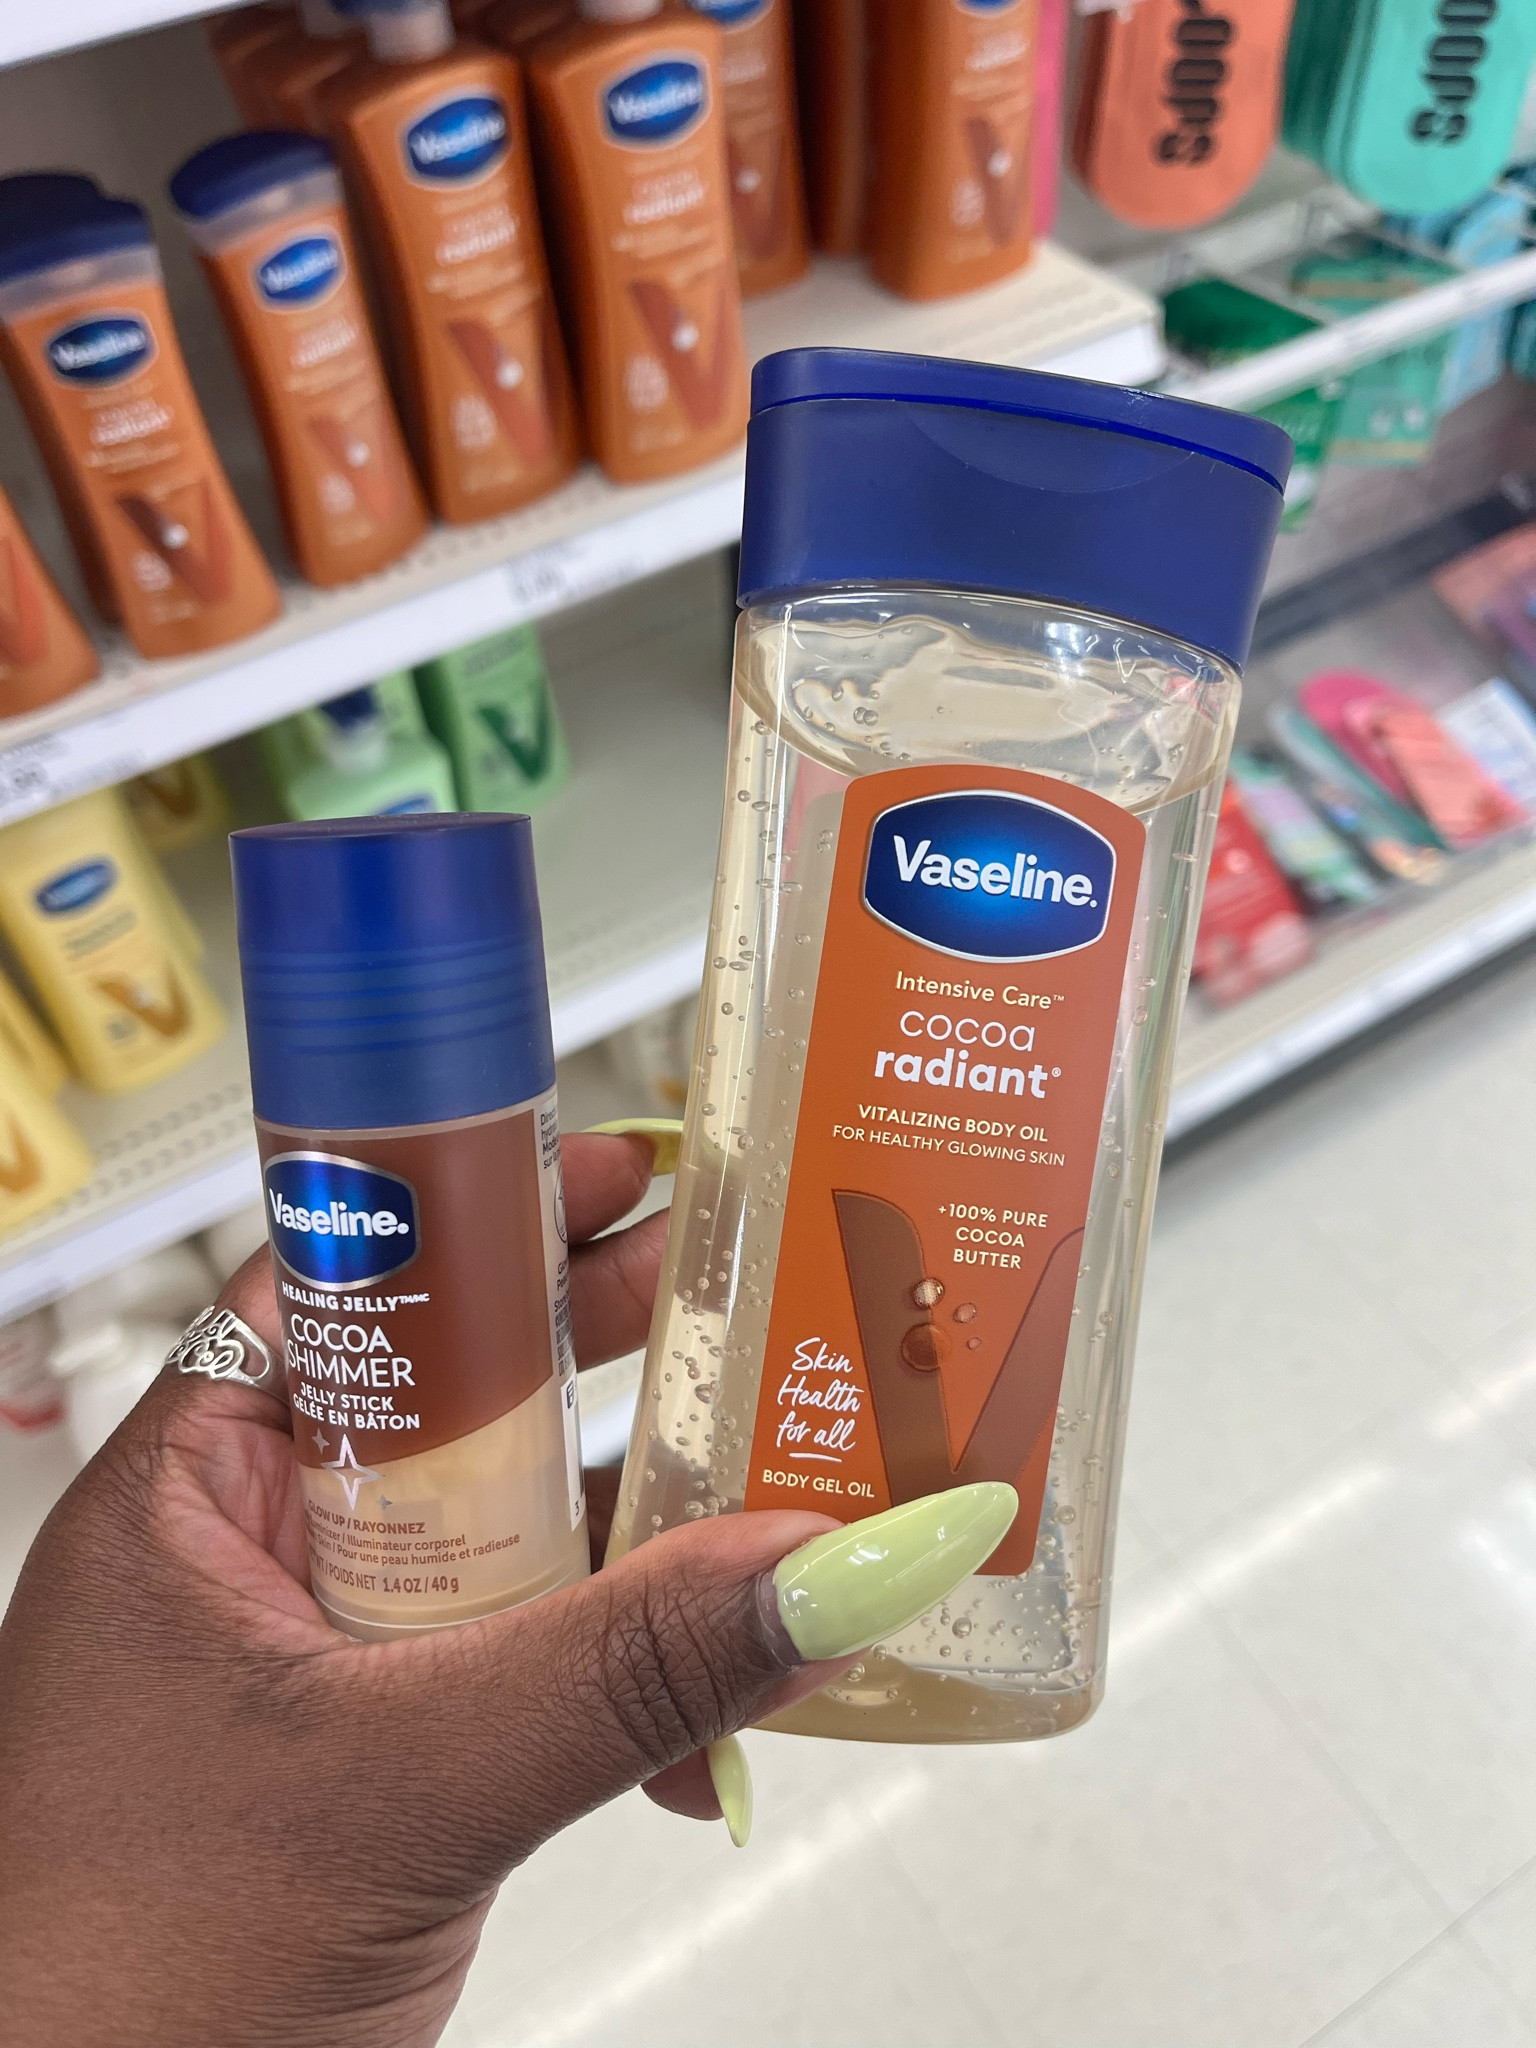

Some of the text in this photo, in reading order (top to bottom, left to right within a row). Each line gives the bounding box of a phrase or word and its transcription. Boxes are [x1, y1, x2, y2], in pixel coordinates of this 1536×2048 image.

[895, 971, 995, 1002] Intensive
[900, 1010, 1035, 1052] cocoa
[858, 1104, 1048, 1142] VITALIZING BODY OIL
[833, 1125, 1065, 1166] FOR HEALTHY GLOWING SKIN
[938, 1203, 1048, 1228] +100% PURE
[956, 1227, 1025, 1247] COCOA
[953, 1249, 1022, 1269] BUTTER
[281, 1280, 339, 1311] HEALING
[290, 1313, 393, 1353] COCOA
[287, 1339, 415, 1388] SHIMMER
[791, 1337, 853, 1374] Skin
[300, 1381, 394, 1412] JELLY STICK
[776, 1374, 864, 1413] Health
[293, 1393, 420, 1430] GELÉE EN BÂTON
[776, 1411, 856, 1451] for all
[762, 1469, 875, 1498] BODY GEL OIL
[331, 1513, 346, 1528] UP
[353, 1519, 426, 1535] RAYONNEZ
[337, 1543, 358, 1561] Pour
[360, 1552, 379, 1564] une
[381, 1553, 409, 1567] peau
[411, 1550, 457, 1565] humide
[459, 1548, 471, 1560] et
[473, 1532, 521, 1557] radieuse
[347, 1532, 411, 1552] Illuminateur
[414, 1533, 466, 1553] corporel
[329, 1563, 355, 1587] POIDS
[356, 1572, 376, 1591] NET
[383, 1578, 401, 1593] 1.4
[403, 1578, 422, 1594] OZ
[431, 1576, 448, 1592] 40
[450, 1577, 460, 1594] g
